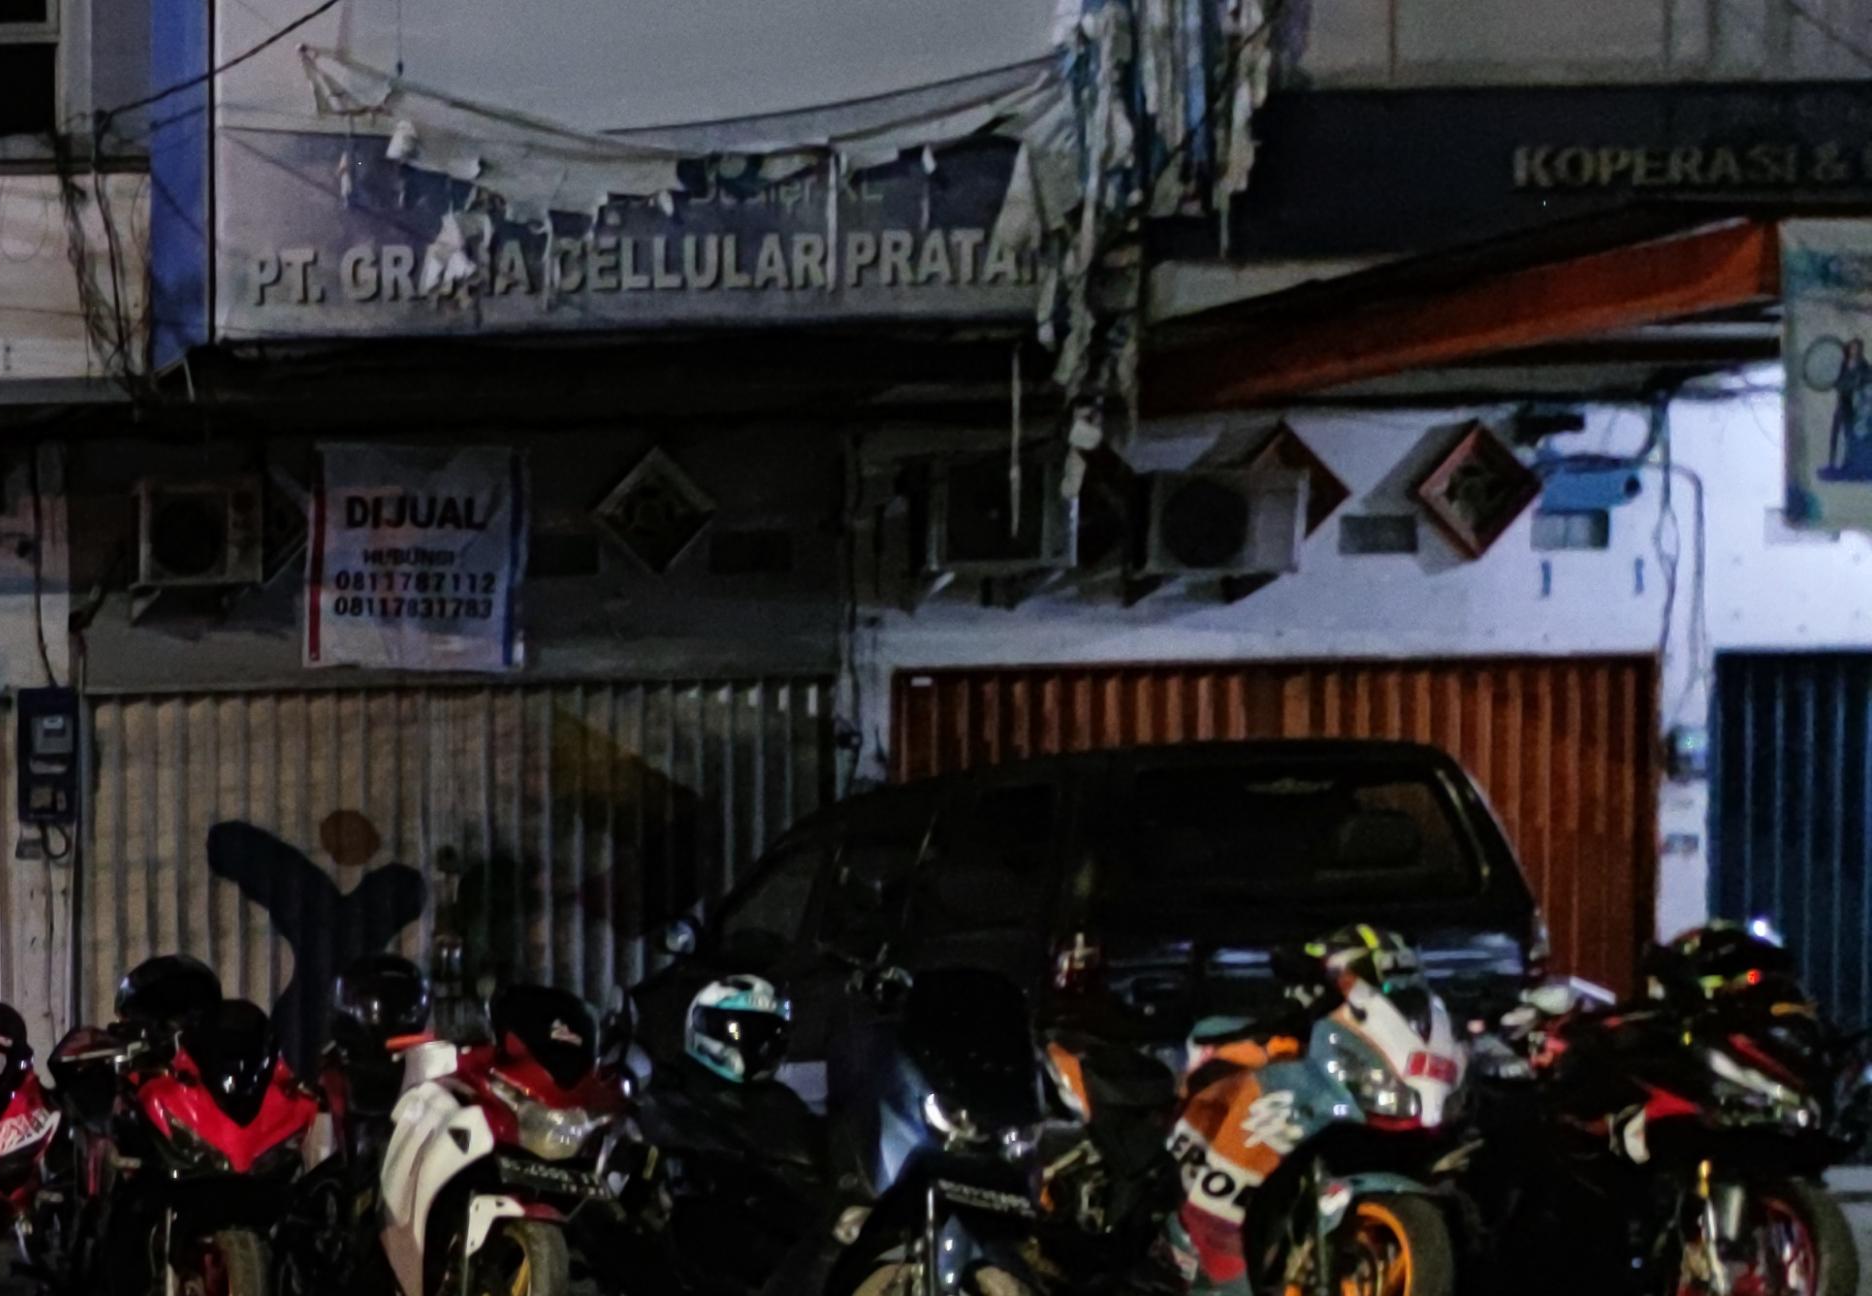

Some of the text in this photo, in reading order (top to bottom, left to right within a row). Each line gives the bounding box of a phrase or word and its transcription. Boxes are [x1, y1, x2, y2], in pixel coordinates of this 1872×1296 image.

[1513, 145, 1797, 187] KOPERASI
[254, 226, 1041, 304] PT. GRAA CELLULAR PRATA
[344, 494, 487, 531] DIJUAL
